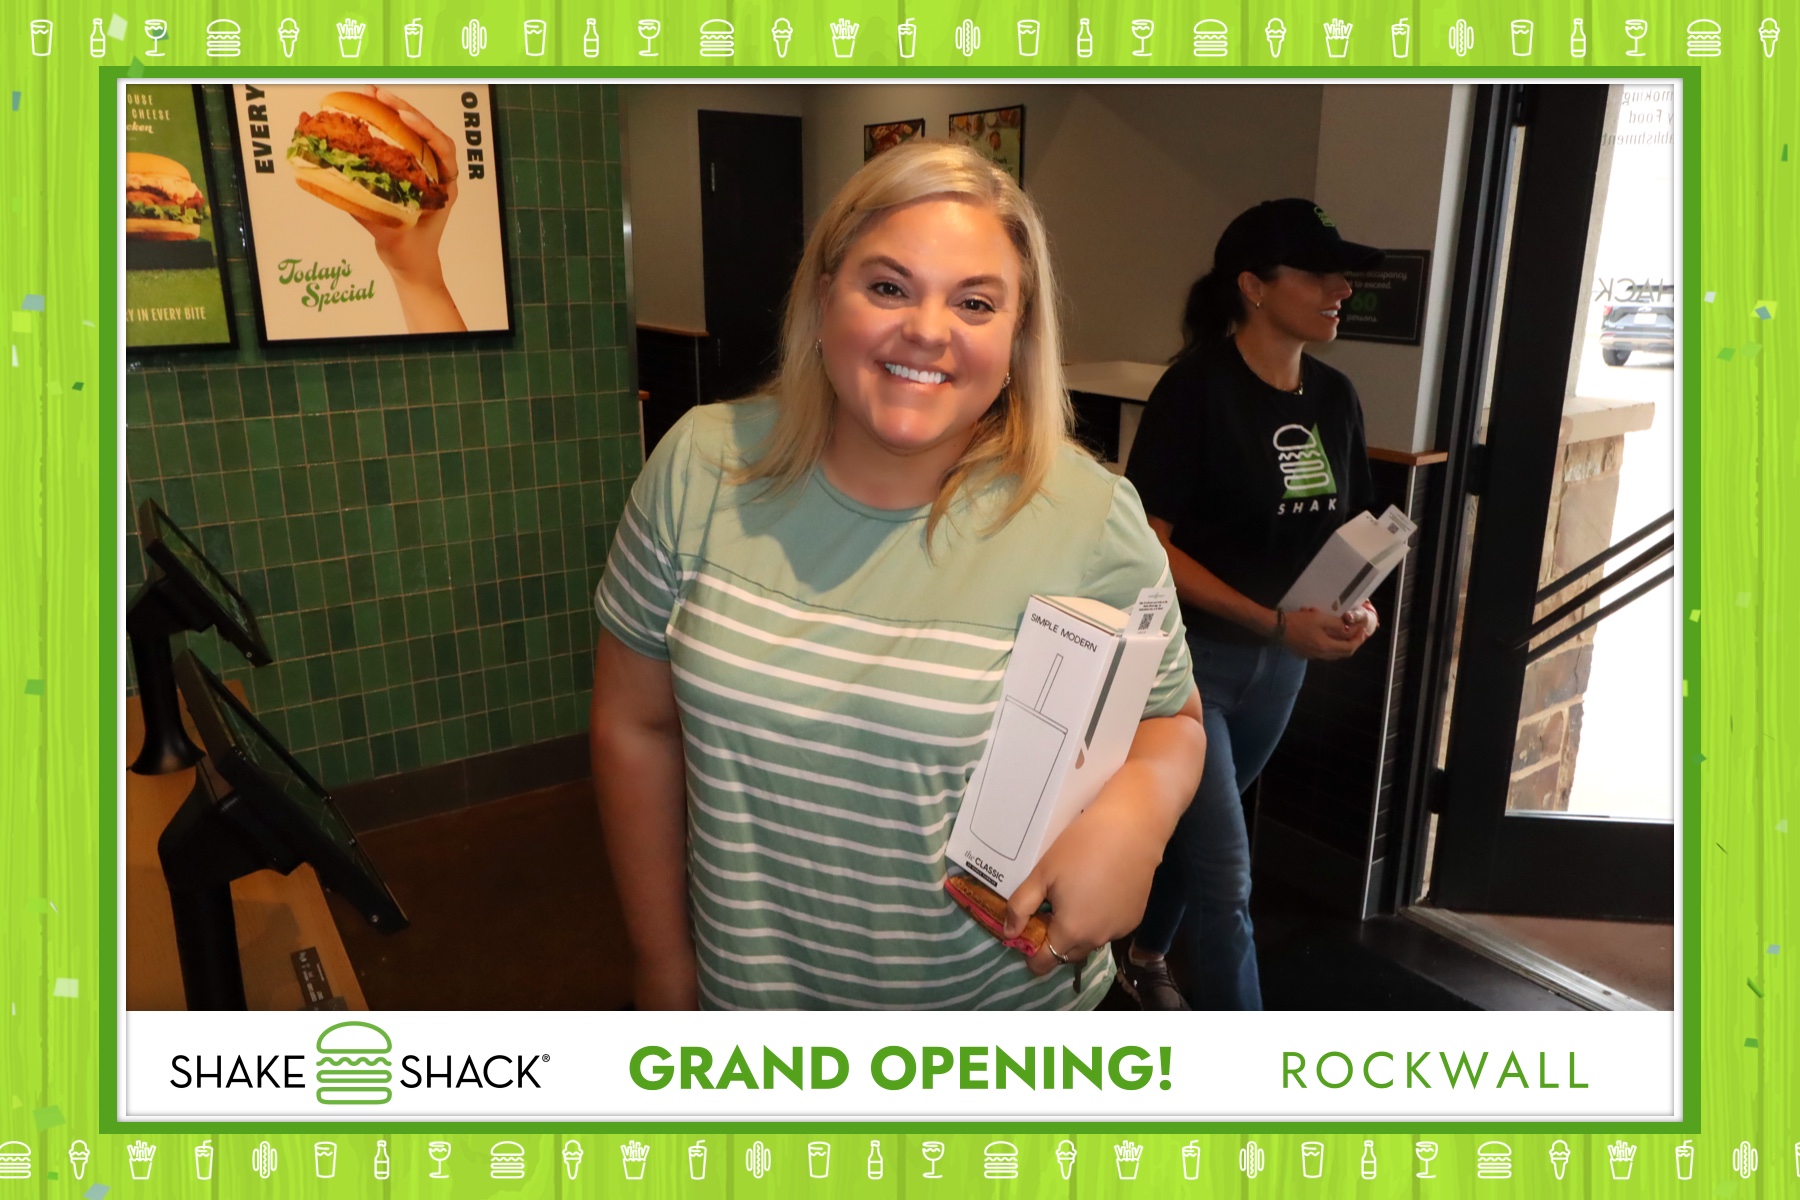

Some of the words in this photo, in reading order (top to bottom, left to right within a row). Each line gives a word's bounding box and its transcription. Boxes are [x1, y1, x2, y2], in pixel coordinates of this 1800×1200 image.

[127, 94, 153, 106] OUSE
[132, 108, 170, 121] CHEESE
[245, 84, 275, 174] EVERY
[461, 91, 485, 180] ORDER
[278, 258, 352, 291] Today's
[301, 279, 375, 313] Special
[137, 308, 149, 321] IN
[151, 307, 181, 321] EVERY
[184, 306, 206, 320] BITE
[1030, 613, 1059, 634] SIMPLE
[1060, 628, 1098, 653] MODERN
[974, 857, 1005, 883] CLASSIC
